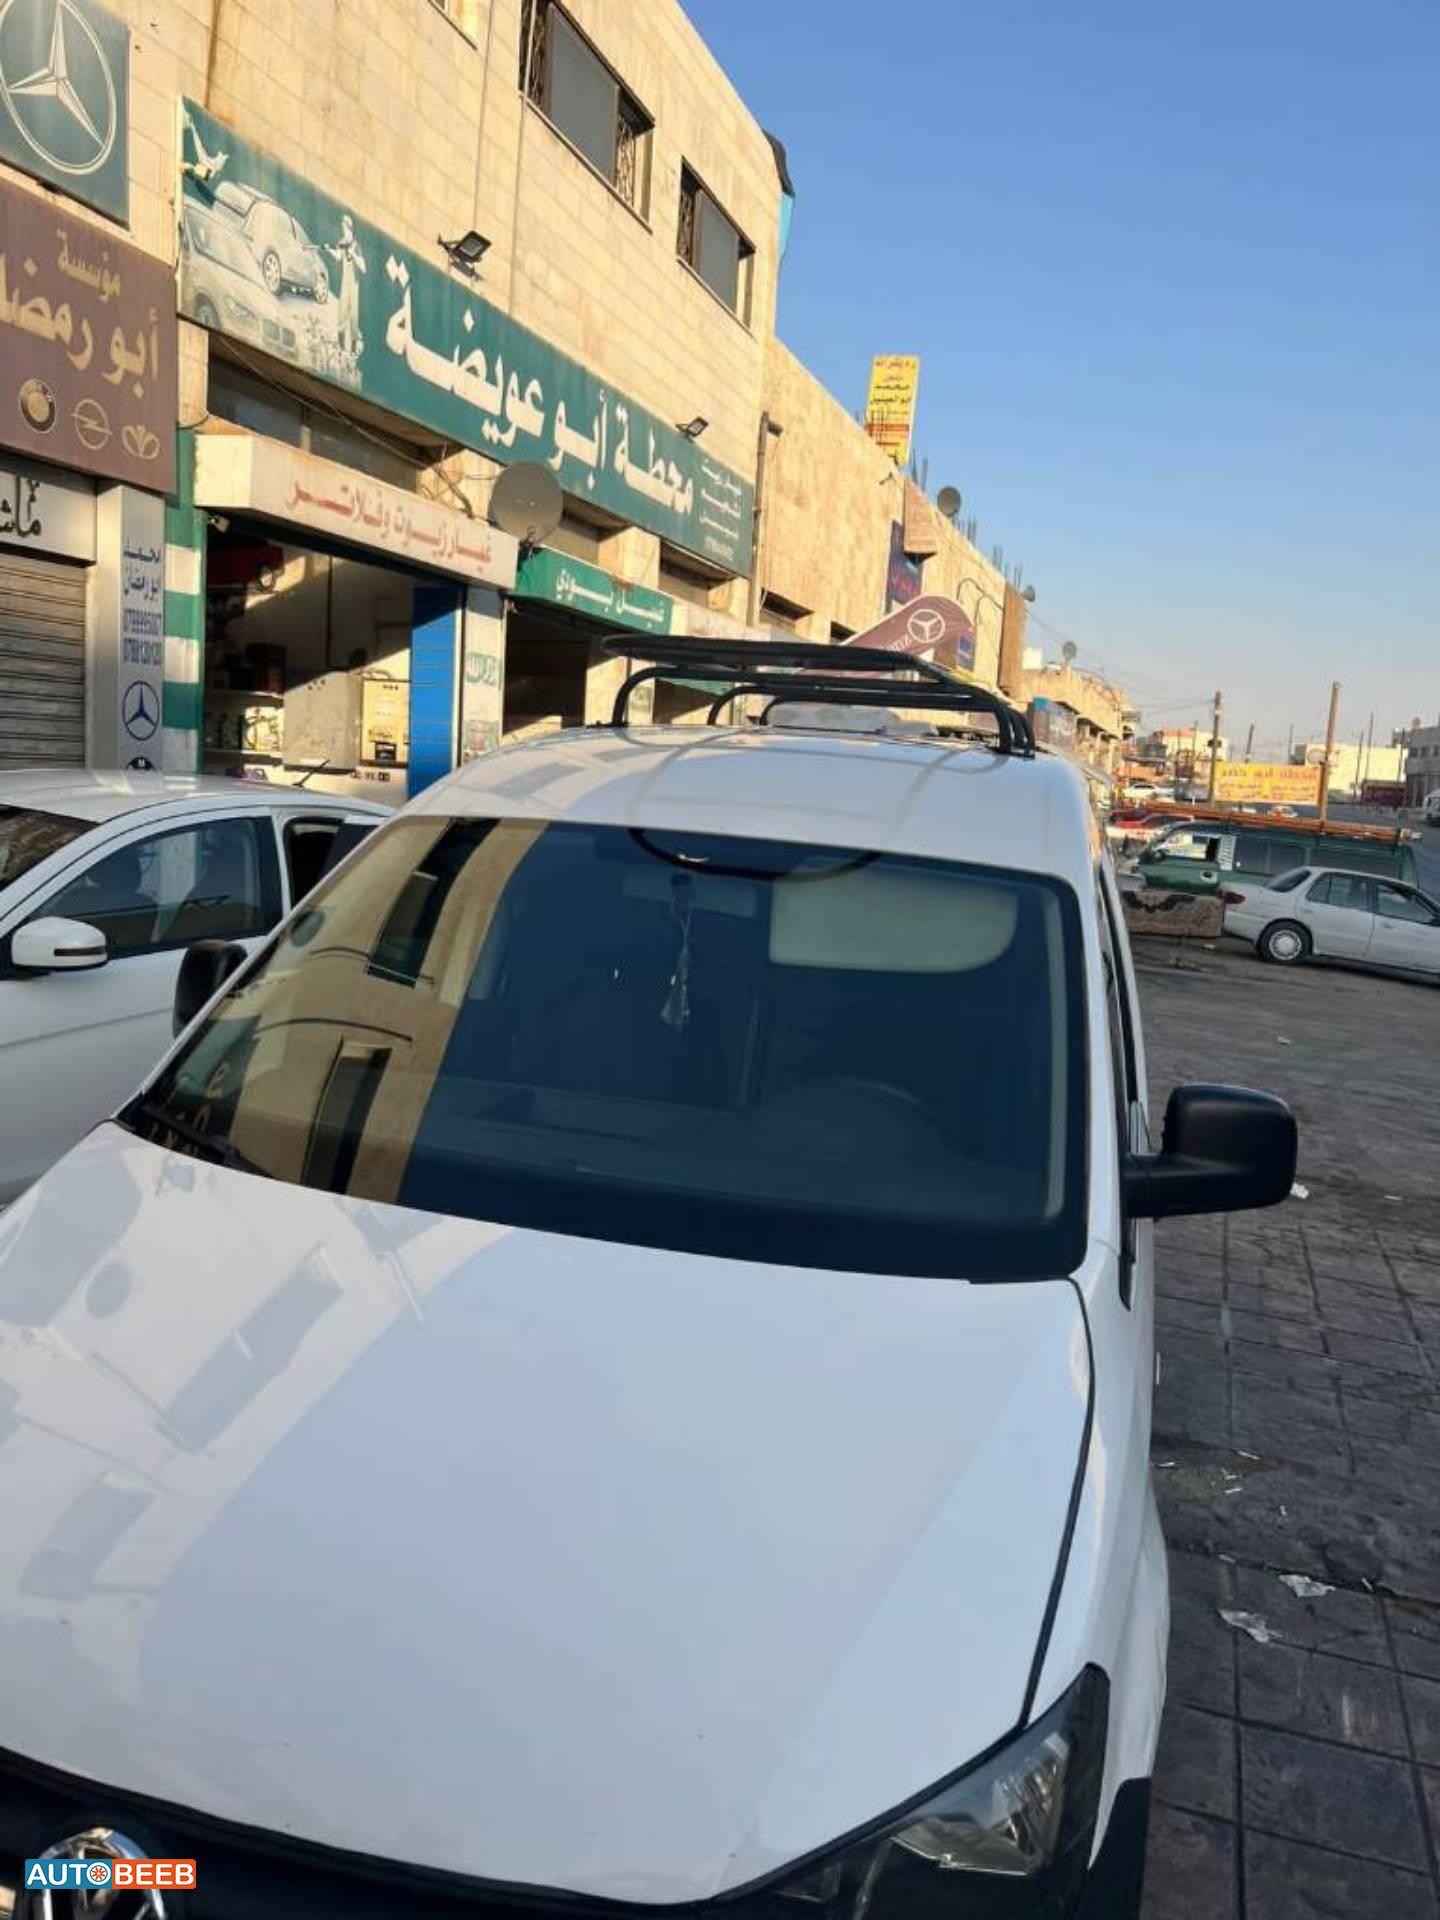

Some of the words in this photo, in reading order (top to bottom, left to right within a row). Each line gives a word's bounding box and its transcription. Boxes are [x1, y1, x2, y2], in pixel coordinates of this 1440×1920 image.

[0, 252, 94, 372] رمضا
[56, 229, 121, 304] مؤسسة
[101, 307, 159, 399] أبو
[384, 254, 546, 449] عويضة
[548, 388, 609, 491] أبو
[612, 404, 694, 516] محطة
